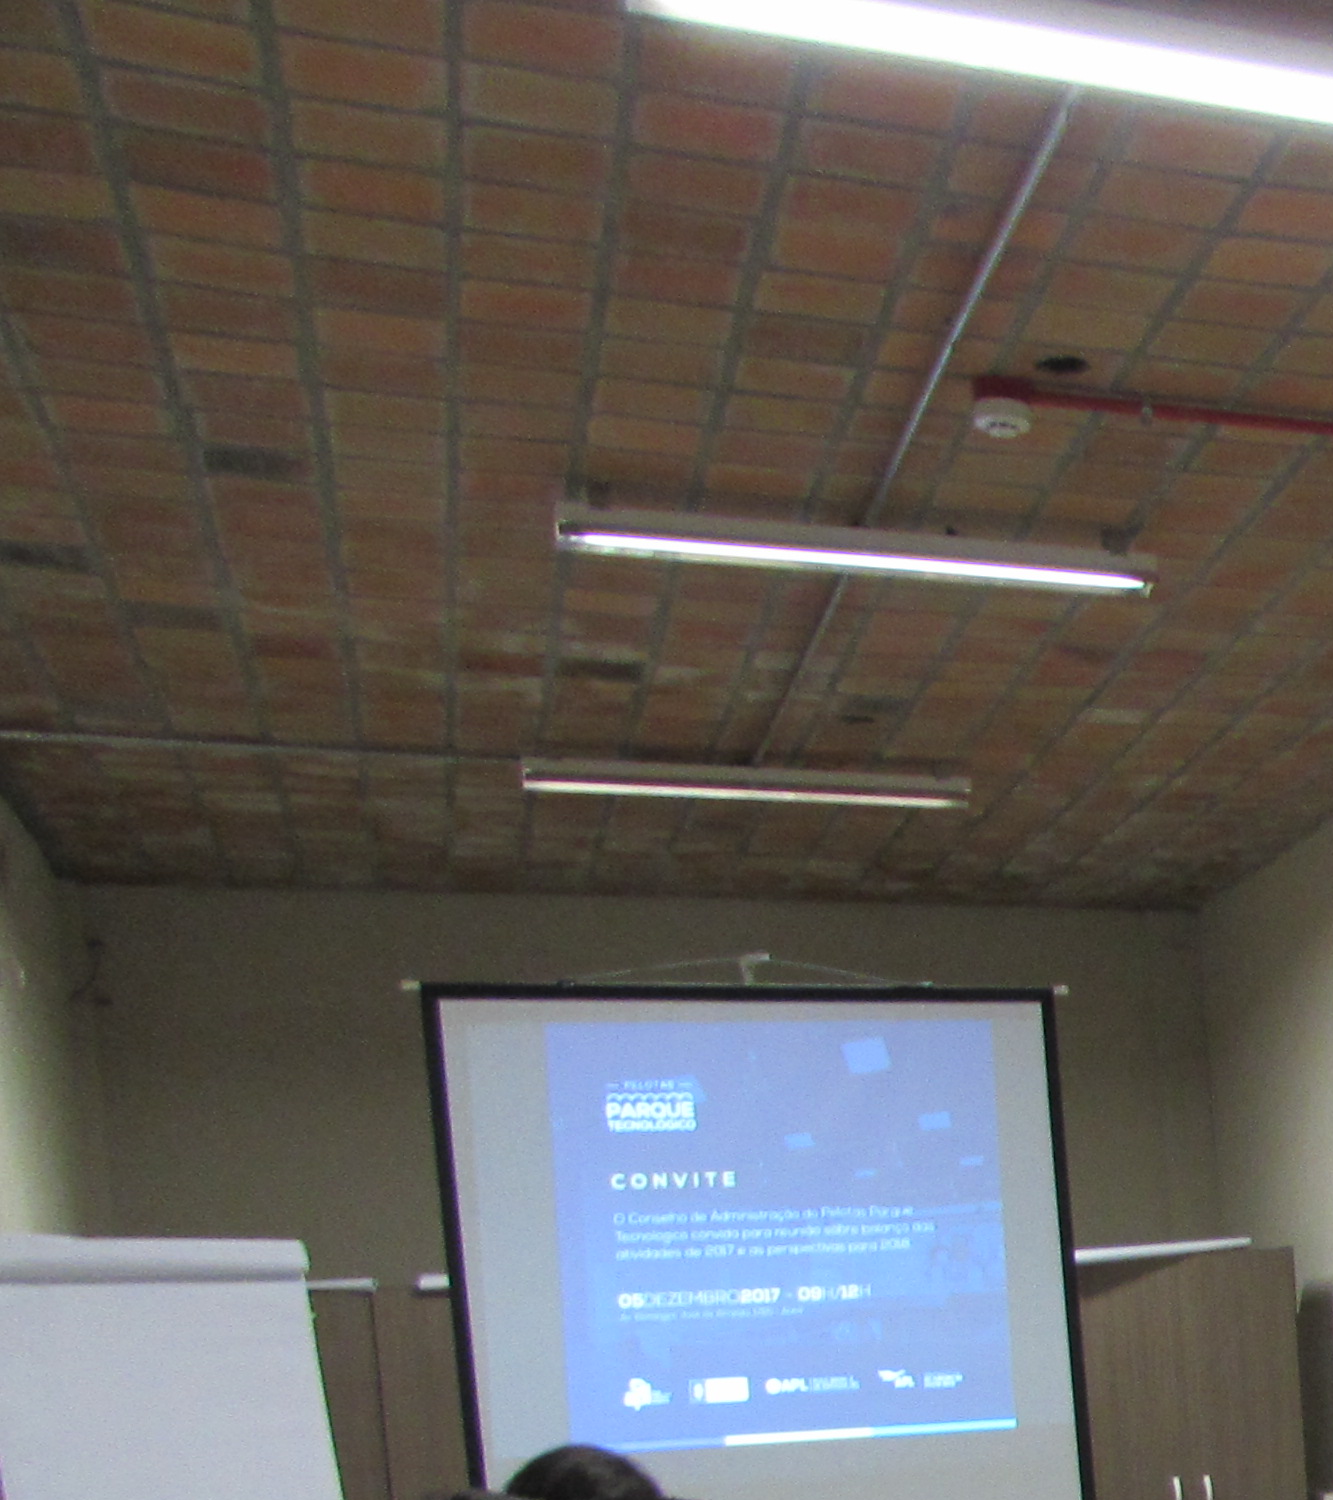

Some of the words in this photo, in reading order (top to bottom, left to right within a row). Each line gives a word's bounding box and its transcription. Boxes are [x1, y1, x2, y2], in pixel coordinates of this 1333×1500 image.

[606, 1101, 695, 1119] PARQUE
[610, 1171, 736, 1190] CONVITE
[705, 1243, 735, 1257] 2017
